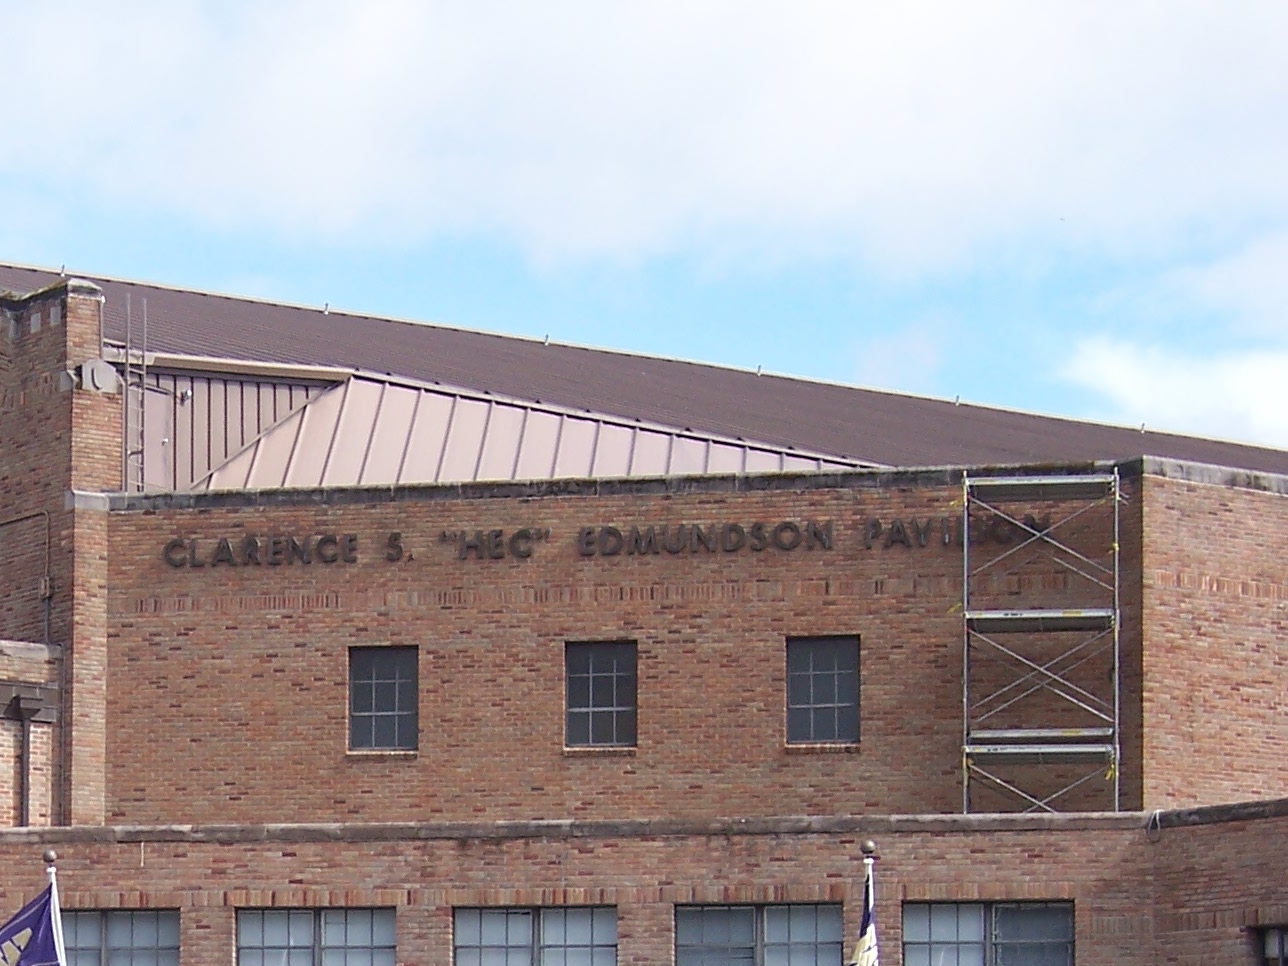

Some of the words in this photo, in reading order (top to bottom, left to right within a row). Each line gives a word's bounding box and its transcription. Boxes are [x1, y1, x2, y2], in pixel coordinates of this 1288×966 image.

[163, 533, 358, 568] CLARENCE
[386, 531, 415, 563] S.
[438, 526, 552, 560] "HEC"
[578, 519, 834, 557] EDMUNDSON
